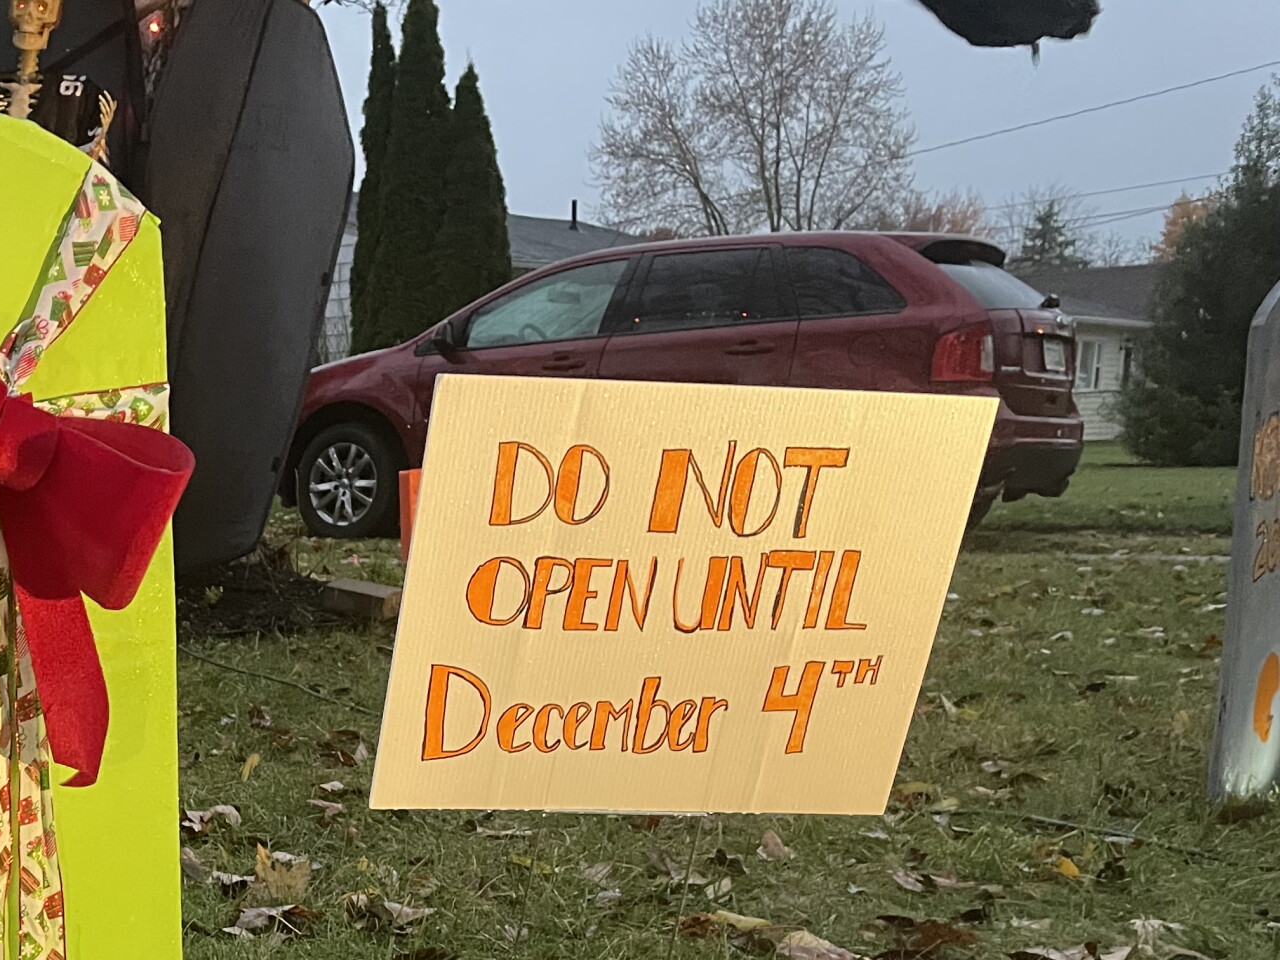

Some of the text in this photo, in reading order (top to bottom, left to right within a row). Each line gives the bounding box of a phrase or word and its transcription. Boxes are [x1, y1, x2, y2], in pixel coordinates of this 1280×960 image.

[489, 440, 851, 538] DO NOT
[466, 549, 868, 634] OPEN UNTIL
[421, 655, 884, 761] December 4TH
